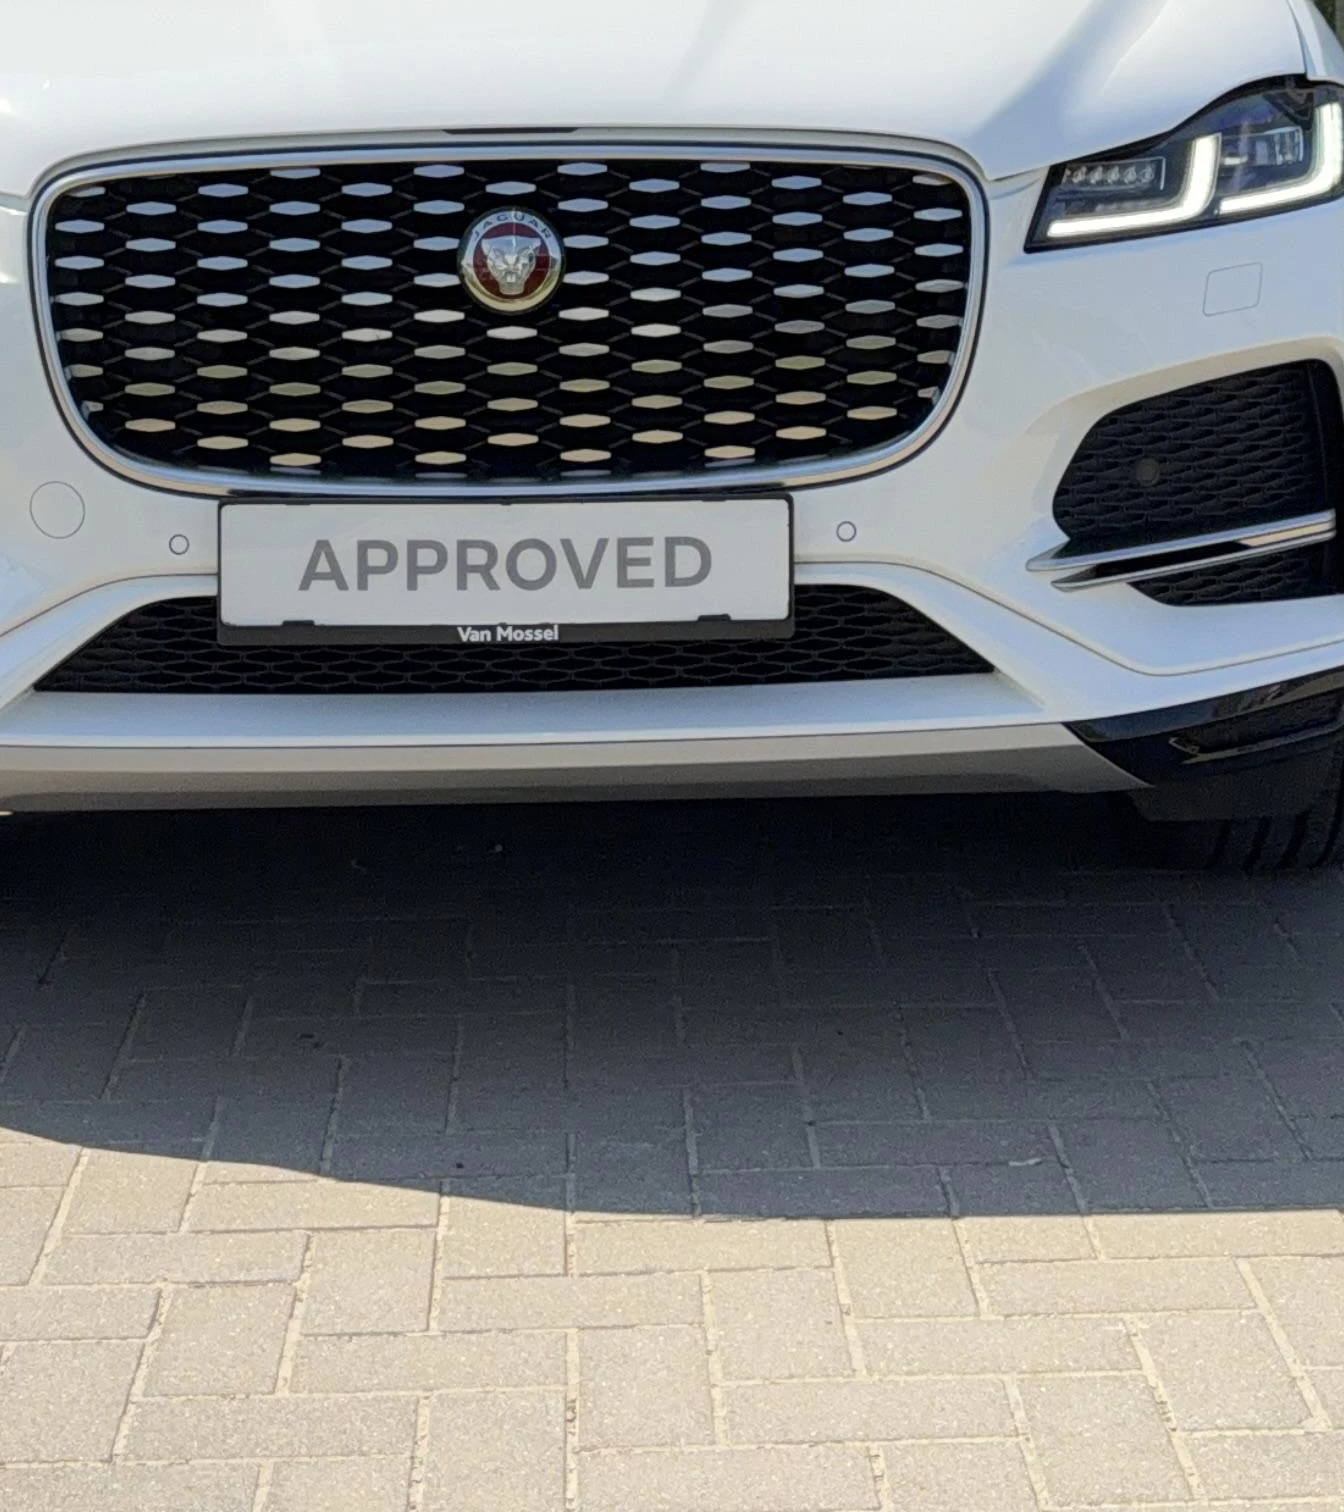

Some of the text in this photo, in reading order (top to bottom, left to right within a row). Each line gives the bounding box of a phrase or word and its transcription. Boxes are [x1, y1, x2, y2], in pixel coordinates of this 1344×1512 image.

[473, 211, 553, 241] JAGUAR
[297, 536, 713, 592] APPROVED
[457, 624, 559, 642] Van Mossel
